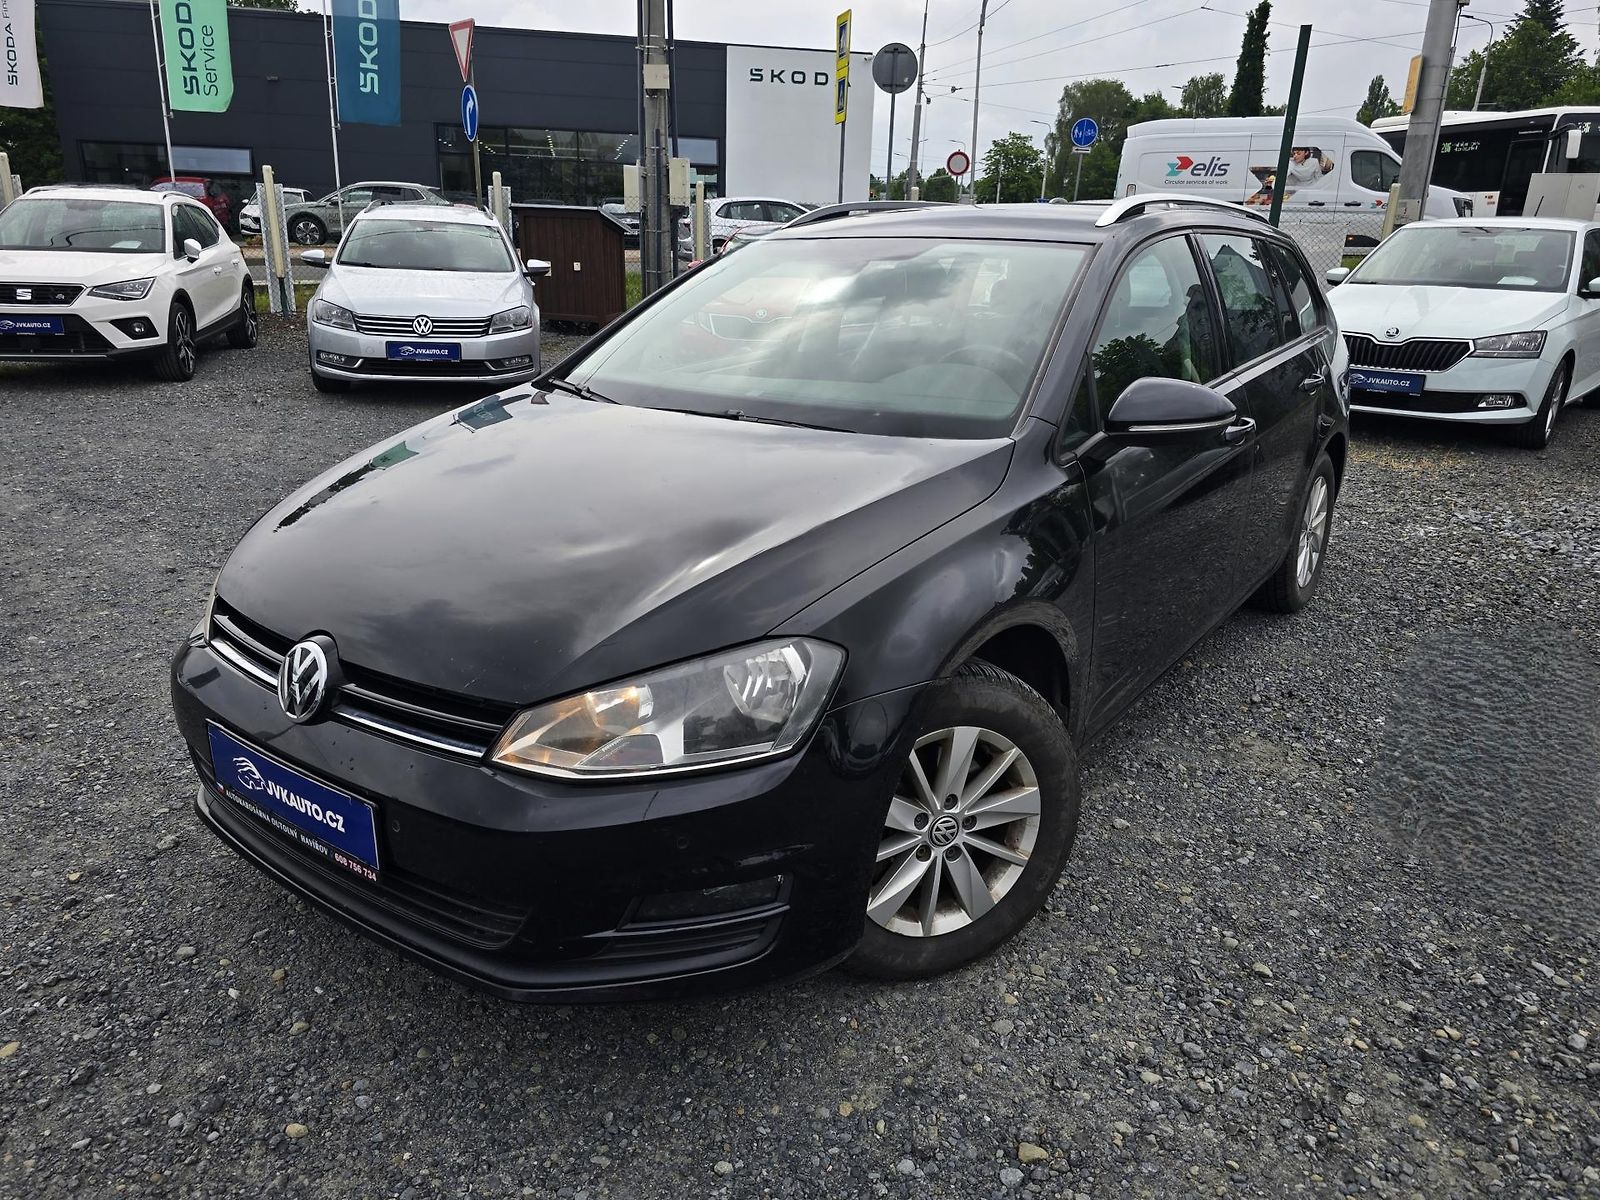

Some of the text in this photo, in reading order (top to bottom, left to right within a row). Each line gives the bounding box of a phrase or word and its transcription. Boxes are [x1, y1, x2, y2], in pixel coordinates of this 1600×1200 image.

[200, 24, 219, 97] Service
[1190, 156, 1231, 177] elis
[1366, 377, 1411, 387] JVKAUTO.CZ
[267, 780, 346, 834] JVKAUTO.CZ
[348, 860, 362, 875] 756
